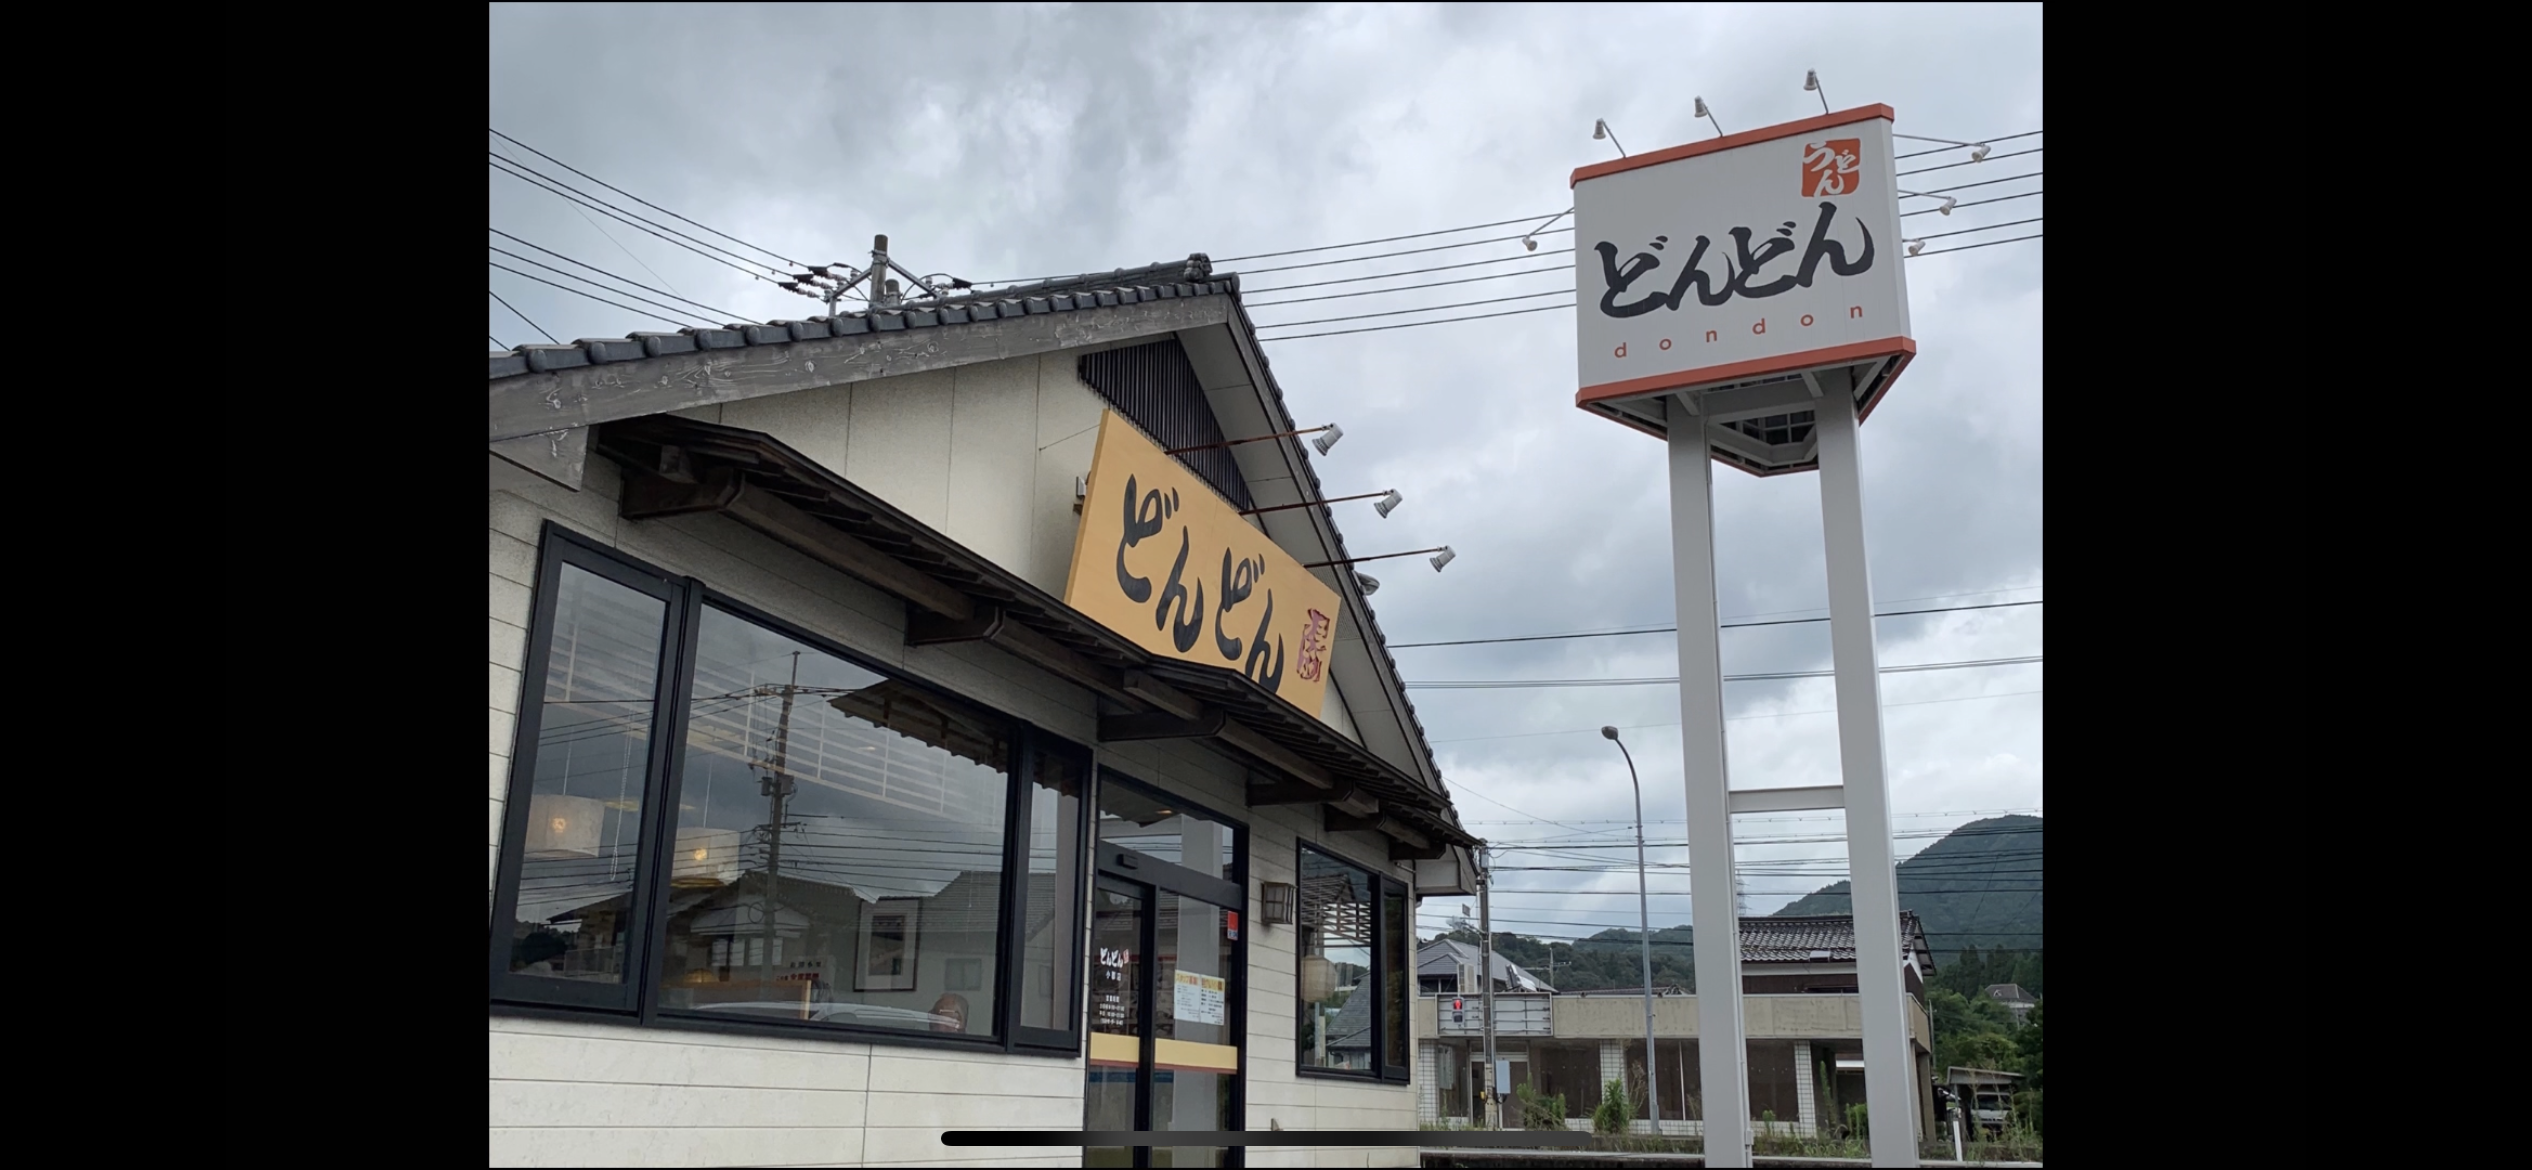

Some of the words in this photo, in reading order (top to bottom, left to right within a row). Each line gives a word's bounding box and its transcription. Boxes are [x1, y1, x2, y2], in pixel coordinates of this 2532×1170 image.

[1802, 141, 1861, 197] うどん
[1594, 201, 1875, 319] どんどん
[1116, 473, 1285, 694] どんどん
[1100, 947, 1123, 968] どんどん
